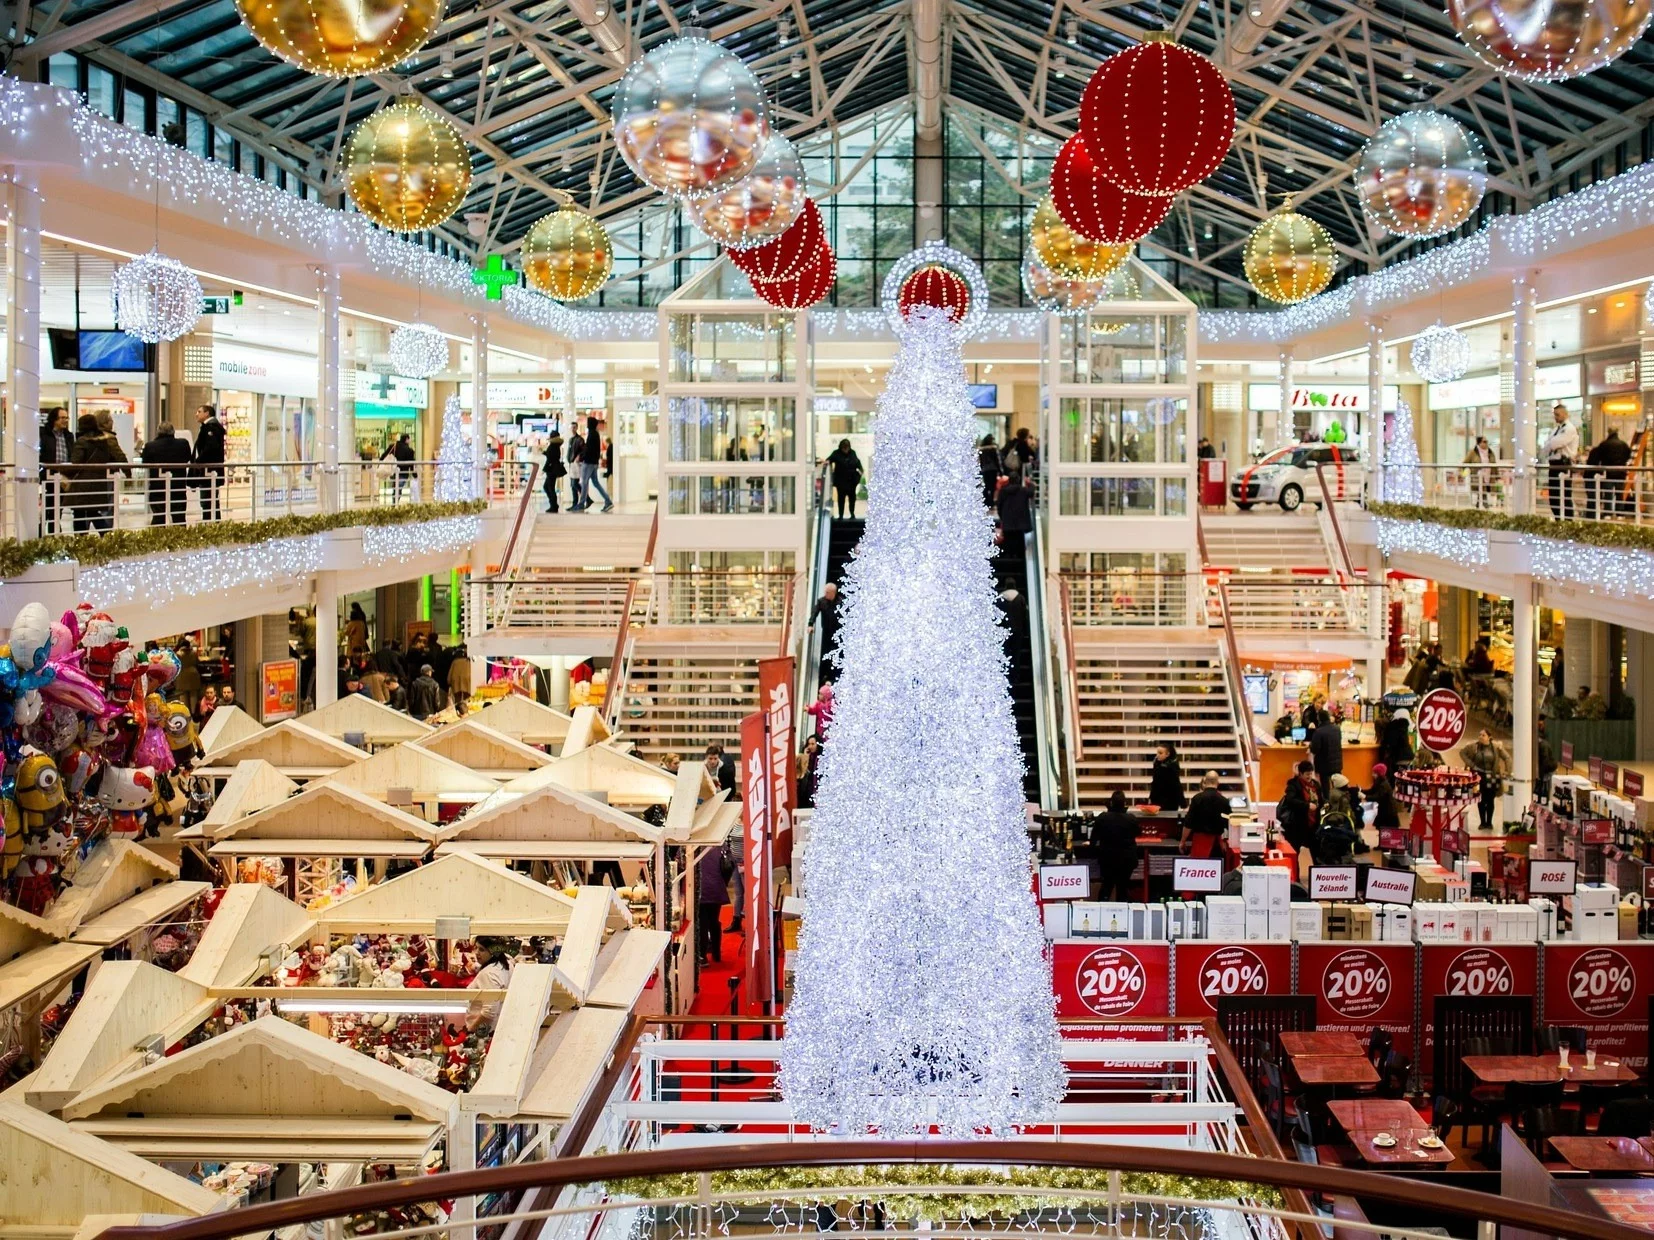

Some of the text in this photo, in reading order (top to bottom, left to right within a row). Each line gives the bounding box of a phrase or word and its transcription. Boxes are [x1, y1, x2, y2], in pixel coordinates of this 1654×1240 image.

[1420, 706, 1464, 734] 20%
[1179, 867, 1216, 878] France
[1540, 872, 1566, 882] ROSÉ
[1046, 876, 1082, 886] Suisse
[1316, 874, 1352, 882] Nouvelle-
[1318, 884, 1348, 892] Zélande
[1371, 880, 1409, 892] Australie
[1216, 951, 1244, 959] mindestens
[1463, 952, 1490, 960] mindestens
[1586, 952, 1612, 960] mindestens
[1229, 958, 1242, 966] moins
[1082, 965, 1142, 996] 20%
[1204, 964, 1264, 996] 20%
[1328, 966, 1386, 998] 20%
[1450, 966, 1509, 996] 20%
[1573, 965, 1632, 998] 20%
[1345, 996, 1374, 1004] Messerabatt
[1590, 995, 1618, 1004] Messerabatt
[1350, 1024, 1366, 1032] und
[1594, 1024, 1610, 1032] und
[1592, 1036, 1626, 1046] profitez!
